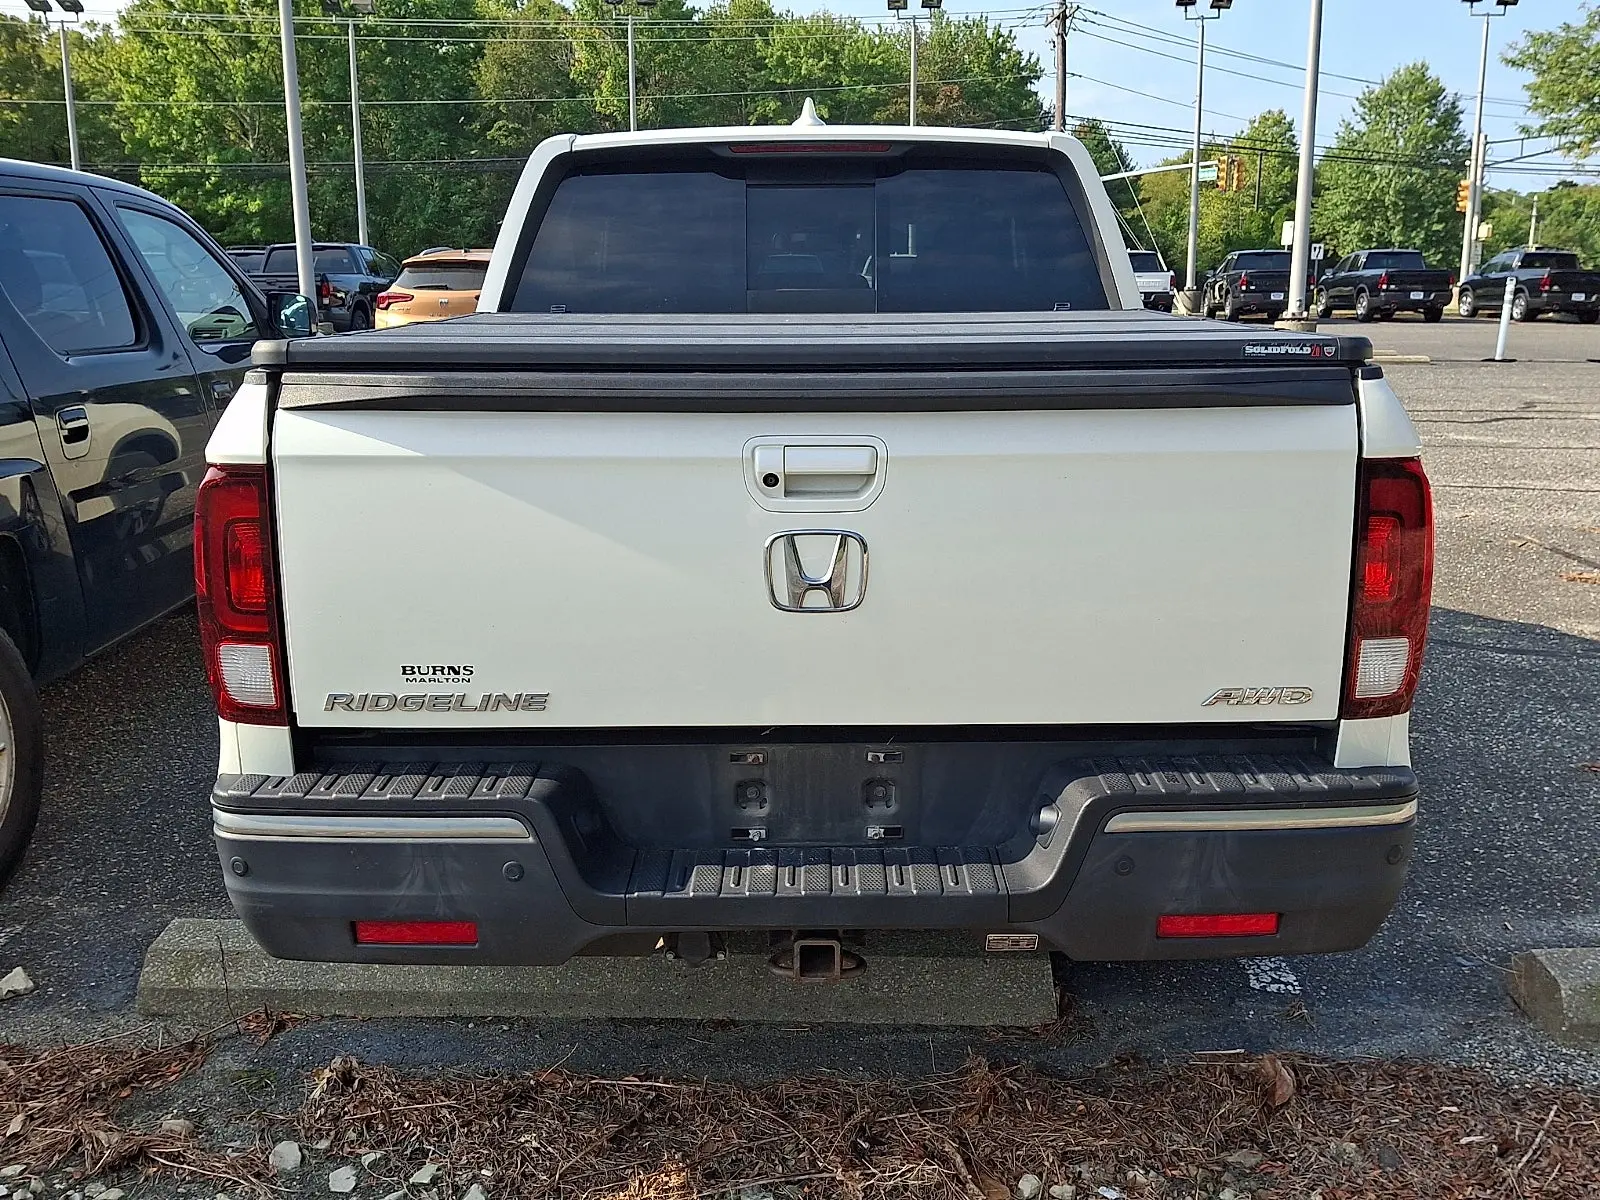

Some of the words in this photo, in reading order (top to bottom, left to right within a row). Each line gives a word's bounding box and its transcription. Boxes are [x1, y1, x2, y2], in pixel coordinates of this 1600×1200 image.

[1244, 345, 1311, 354] SOLIDFOLD
[400, 665, 474, 676] BURNS
[323, 692, 550, 712] RIDGELINE
[1201, 686, 1313, 706] AWD
